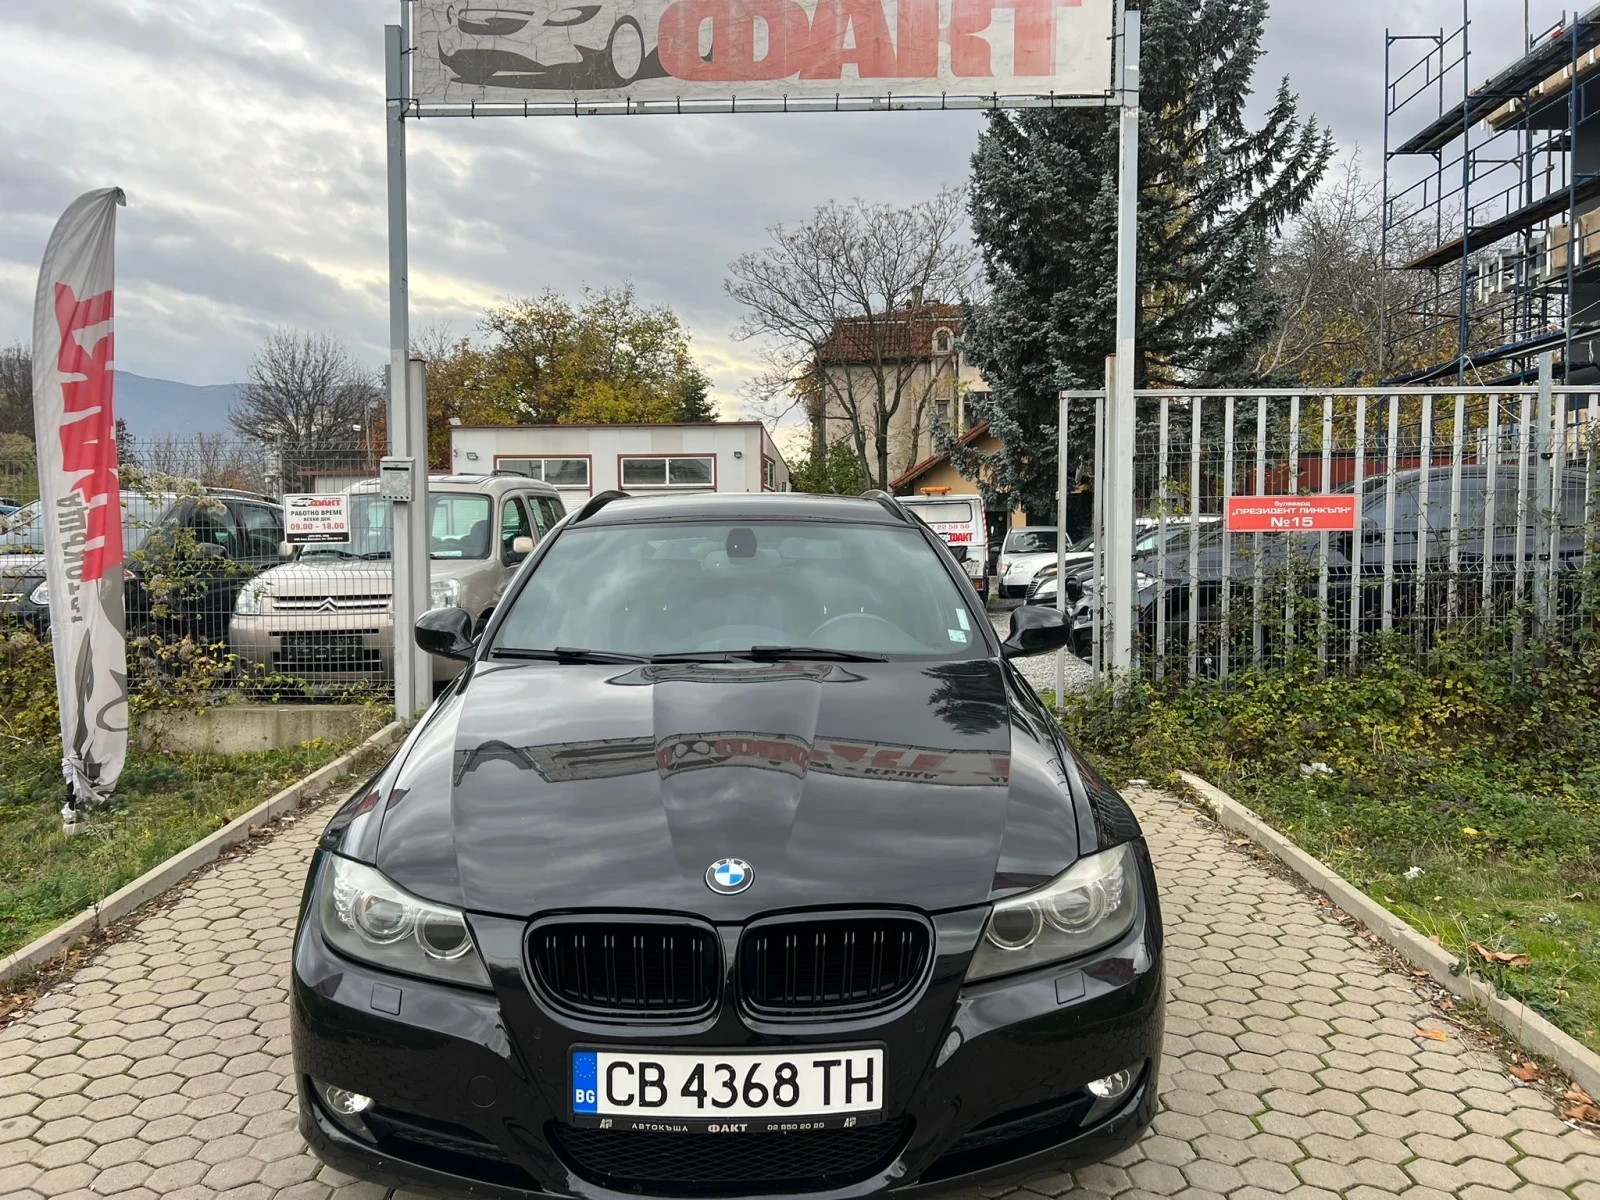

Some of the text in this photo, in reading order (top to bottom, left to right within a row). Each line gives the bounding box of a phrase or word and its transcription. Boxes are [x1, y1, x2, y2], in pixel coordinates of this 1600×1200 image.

[606, 1057, 875, 1109] CB 4368 TH
[576, 1090, 596, 1103] BG
[708, 1123, 748, 1133] ФАКТ
[799, 1122, 811, 1130] 20
